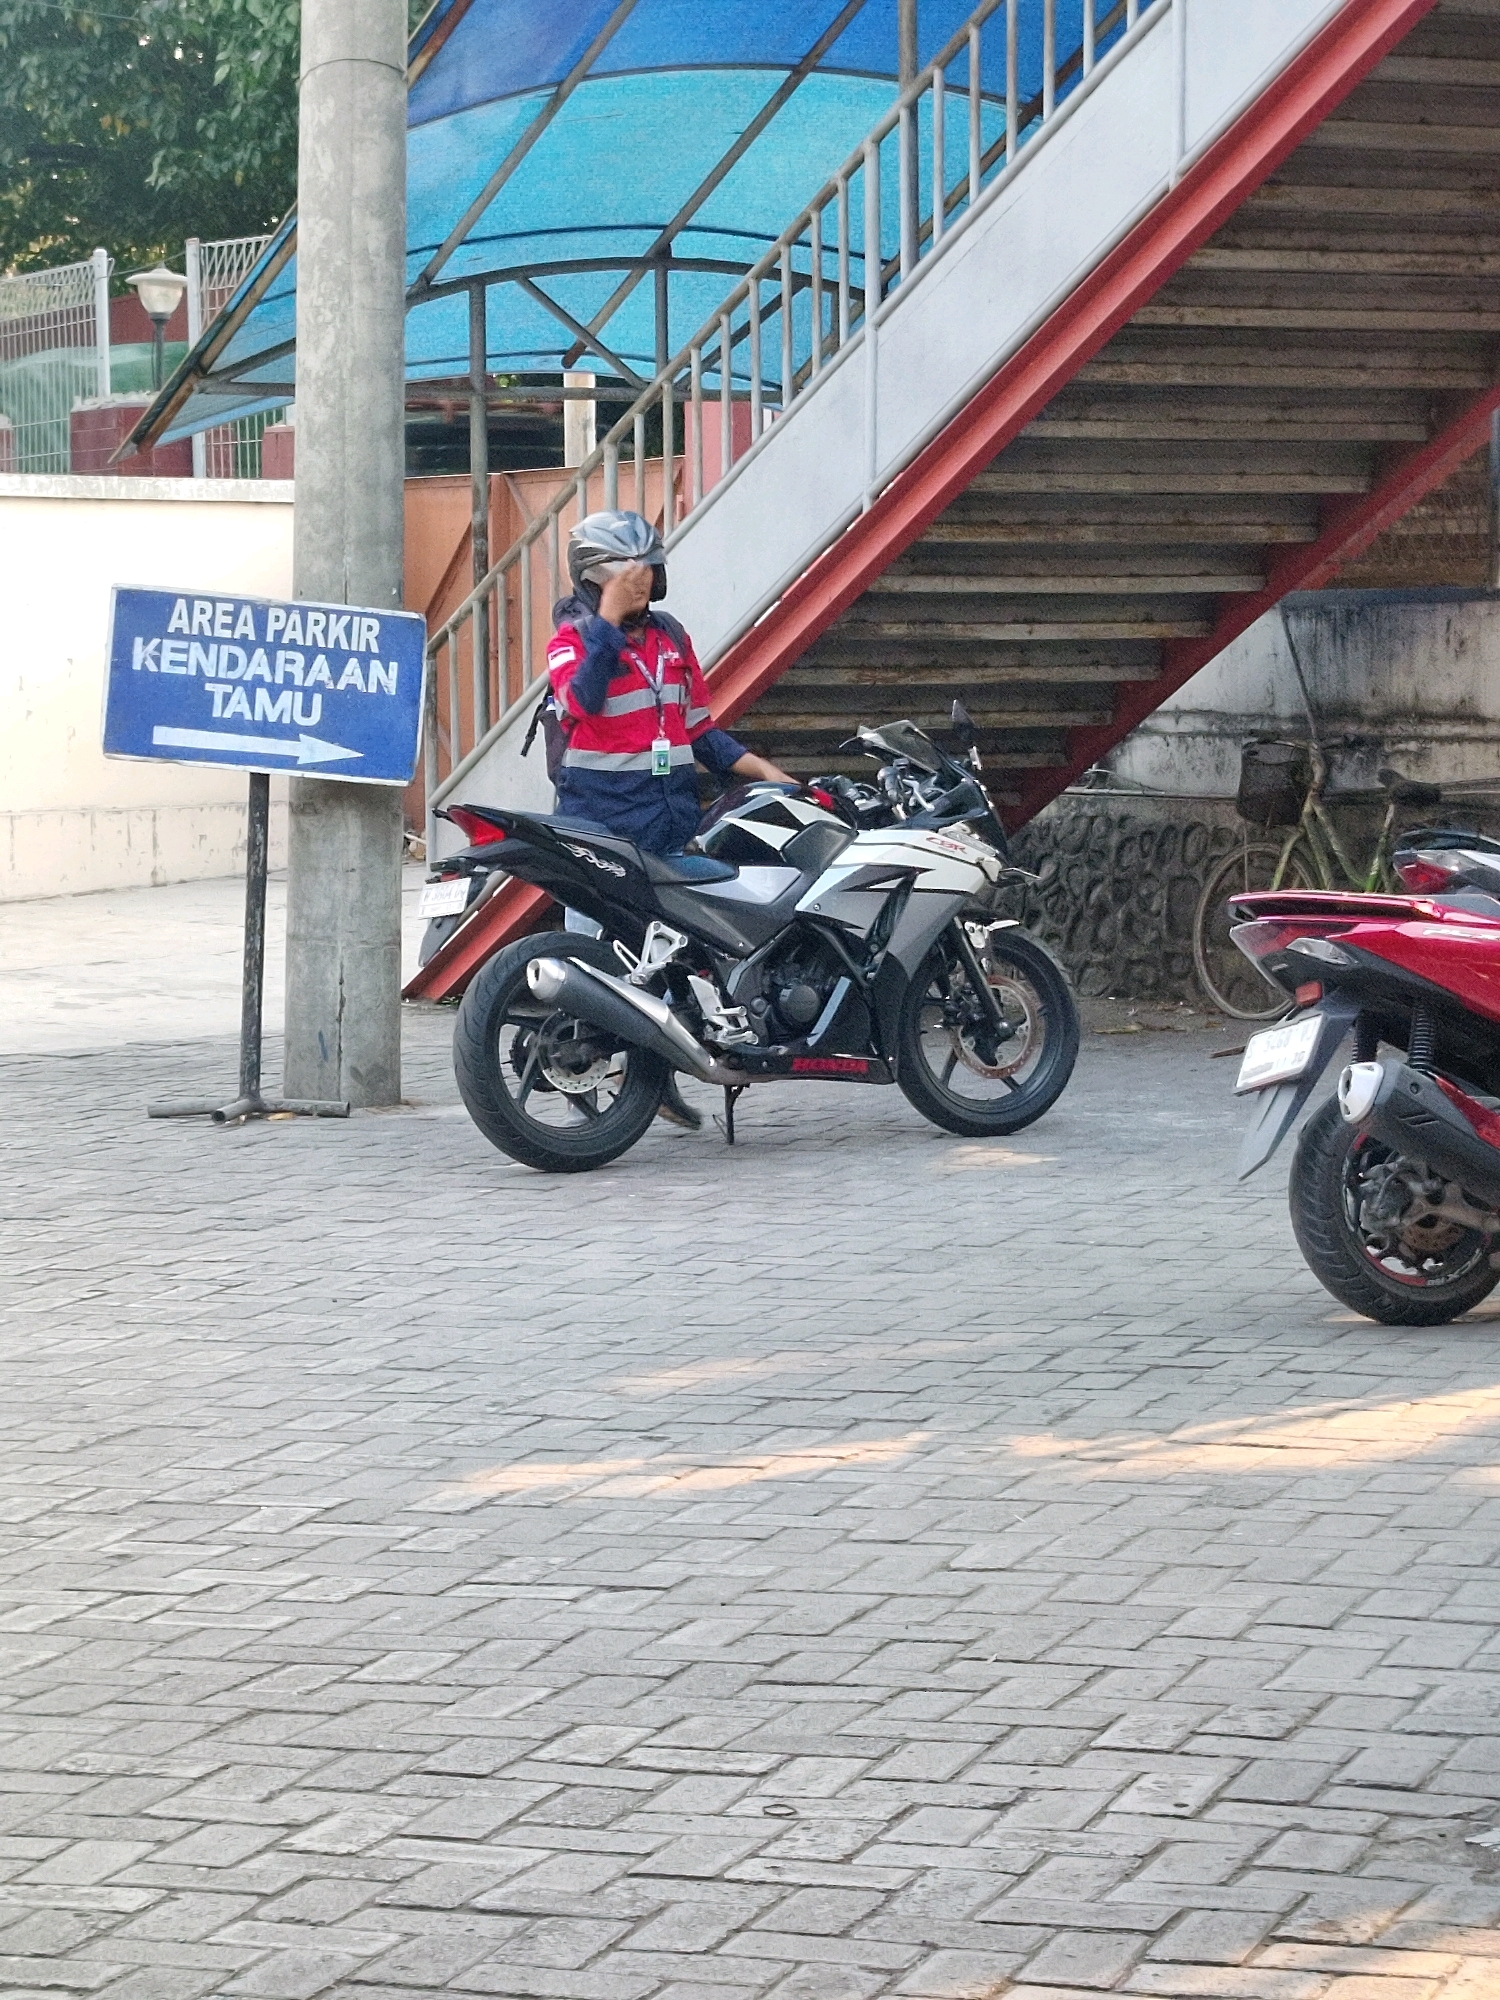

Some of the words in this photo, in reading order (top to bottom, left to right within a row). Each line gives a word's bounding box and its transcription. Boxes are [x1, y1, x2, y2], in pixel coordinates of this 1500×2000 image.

[167, 598, 256, 641] AREA
[266, 607, 380, 653] PARKIR
[132, 636, 398, 695] KENDARAAN
[205, 683, 323, 726] TAMU
[926, 837, 967, 854] CBR
